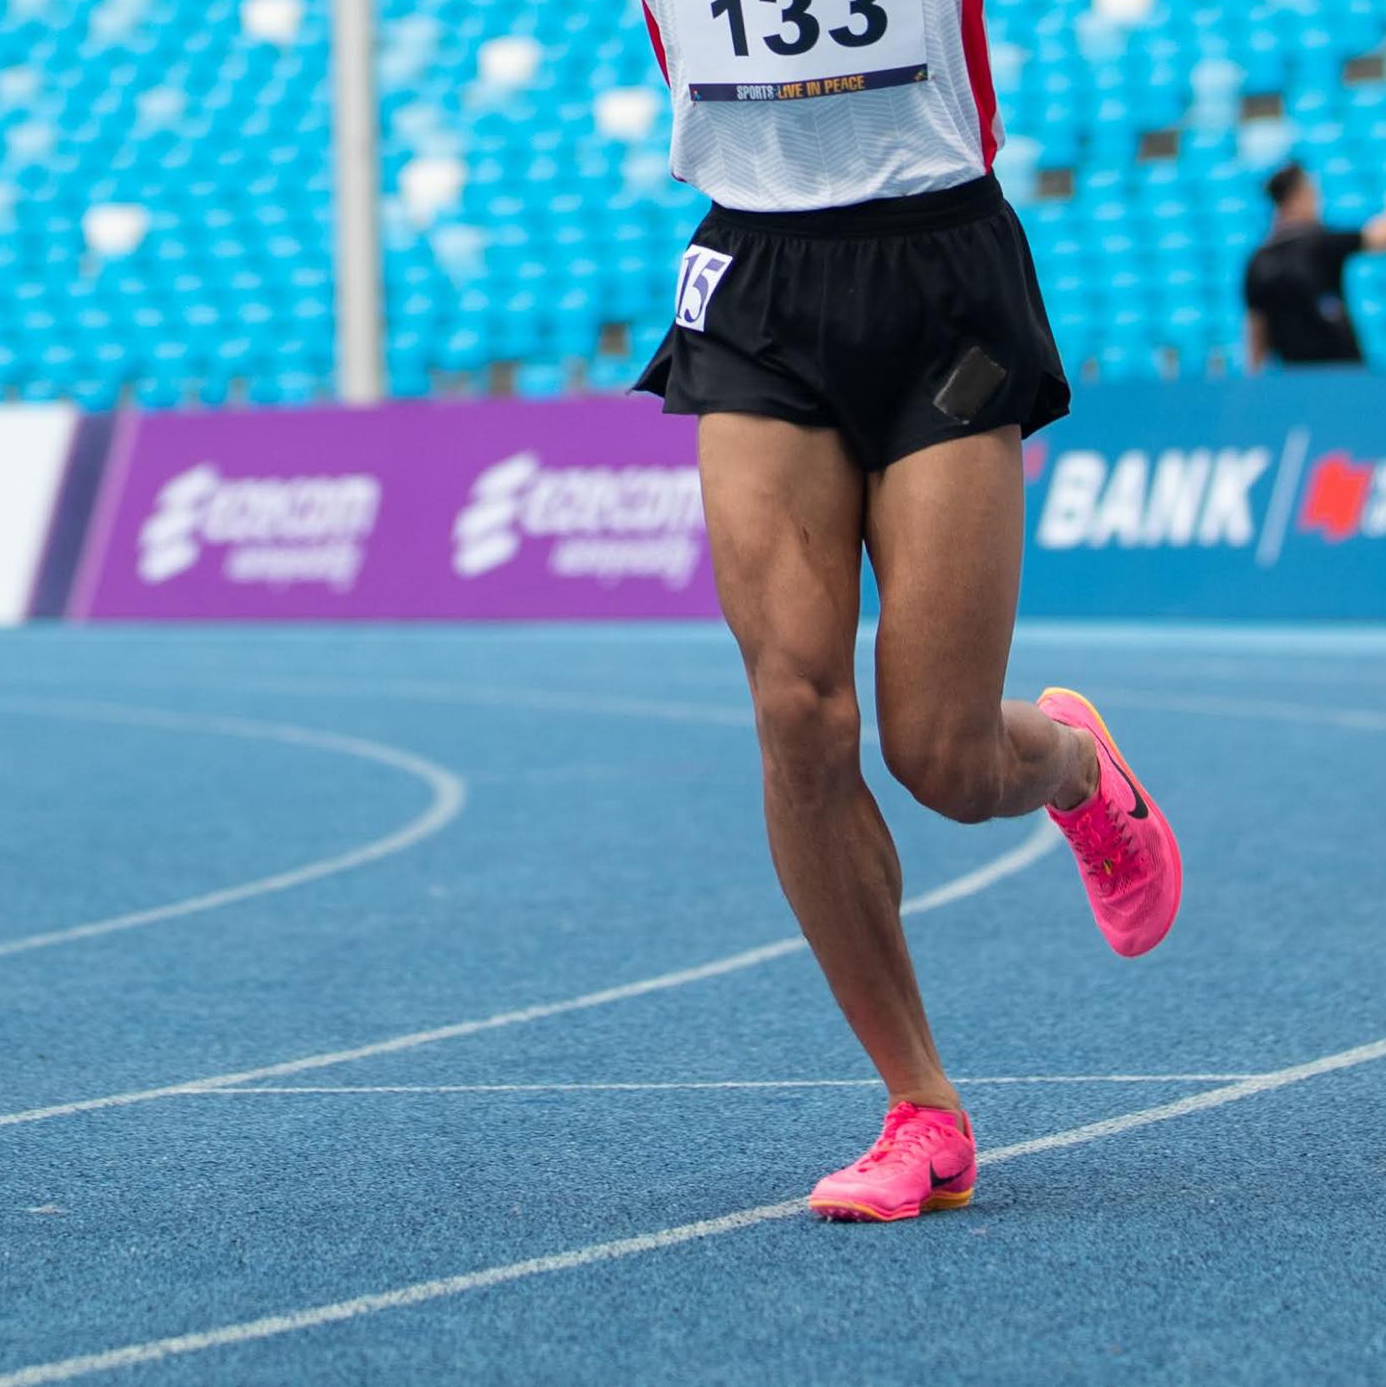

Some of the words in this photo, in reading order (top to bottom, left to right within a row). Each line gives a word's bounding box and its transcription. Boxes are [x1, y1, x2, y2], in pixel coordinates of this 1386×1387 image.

[777, 83, 804, 100] LIVE
[806, 81, 822, 97] IN
[824, 74, 866, 94] PEACE
[1035, 445, 1272, 551] BANK
